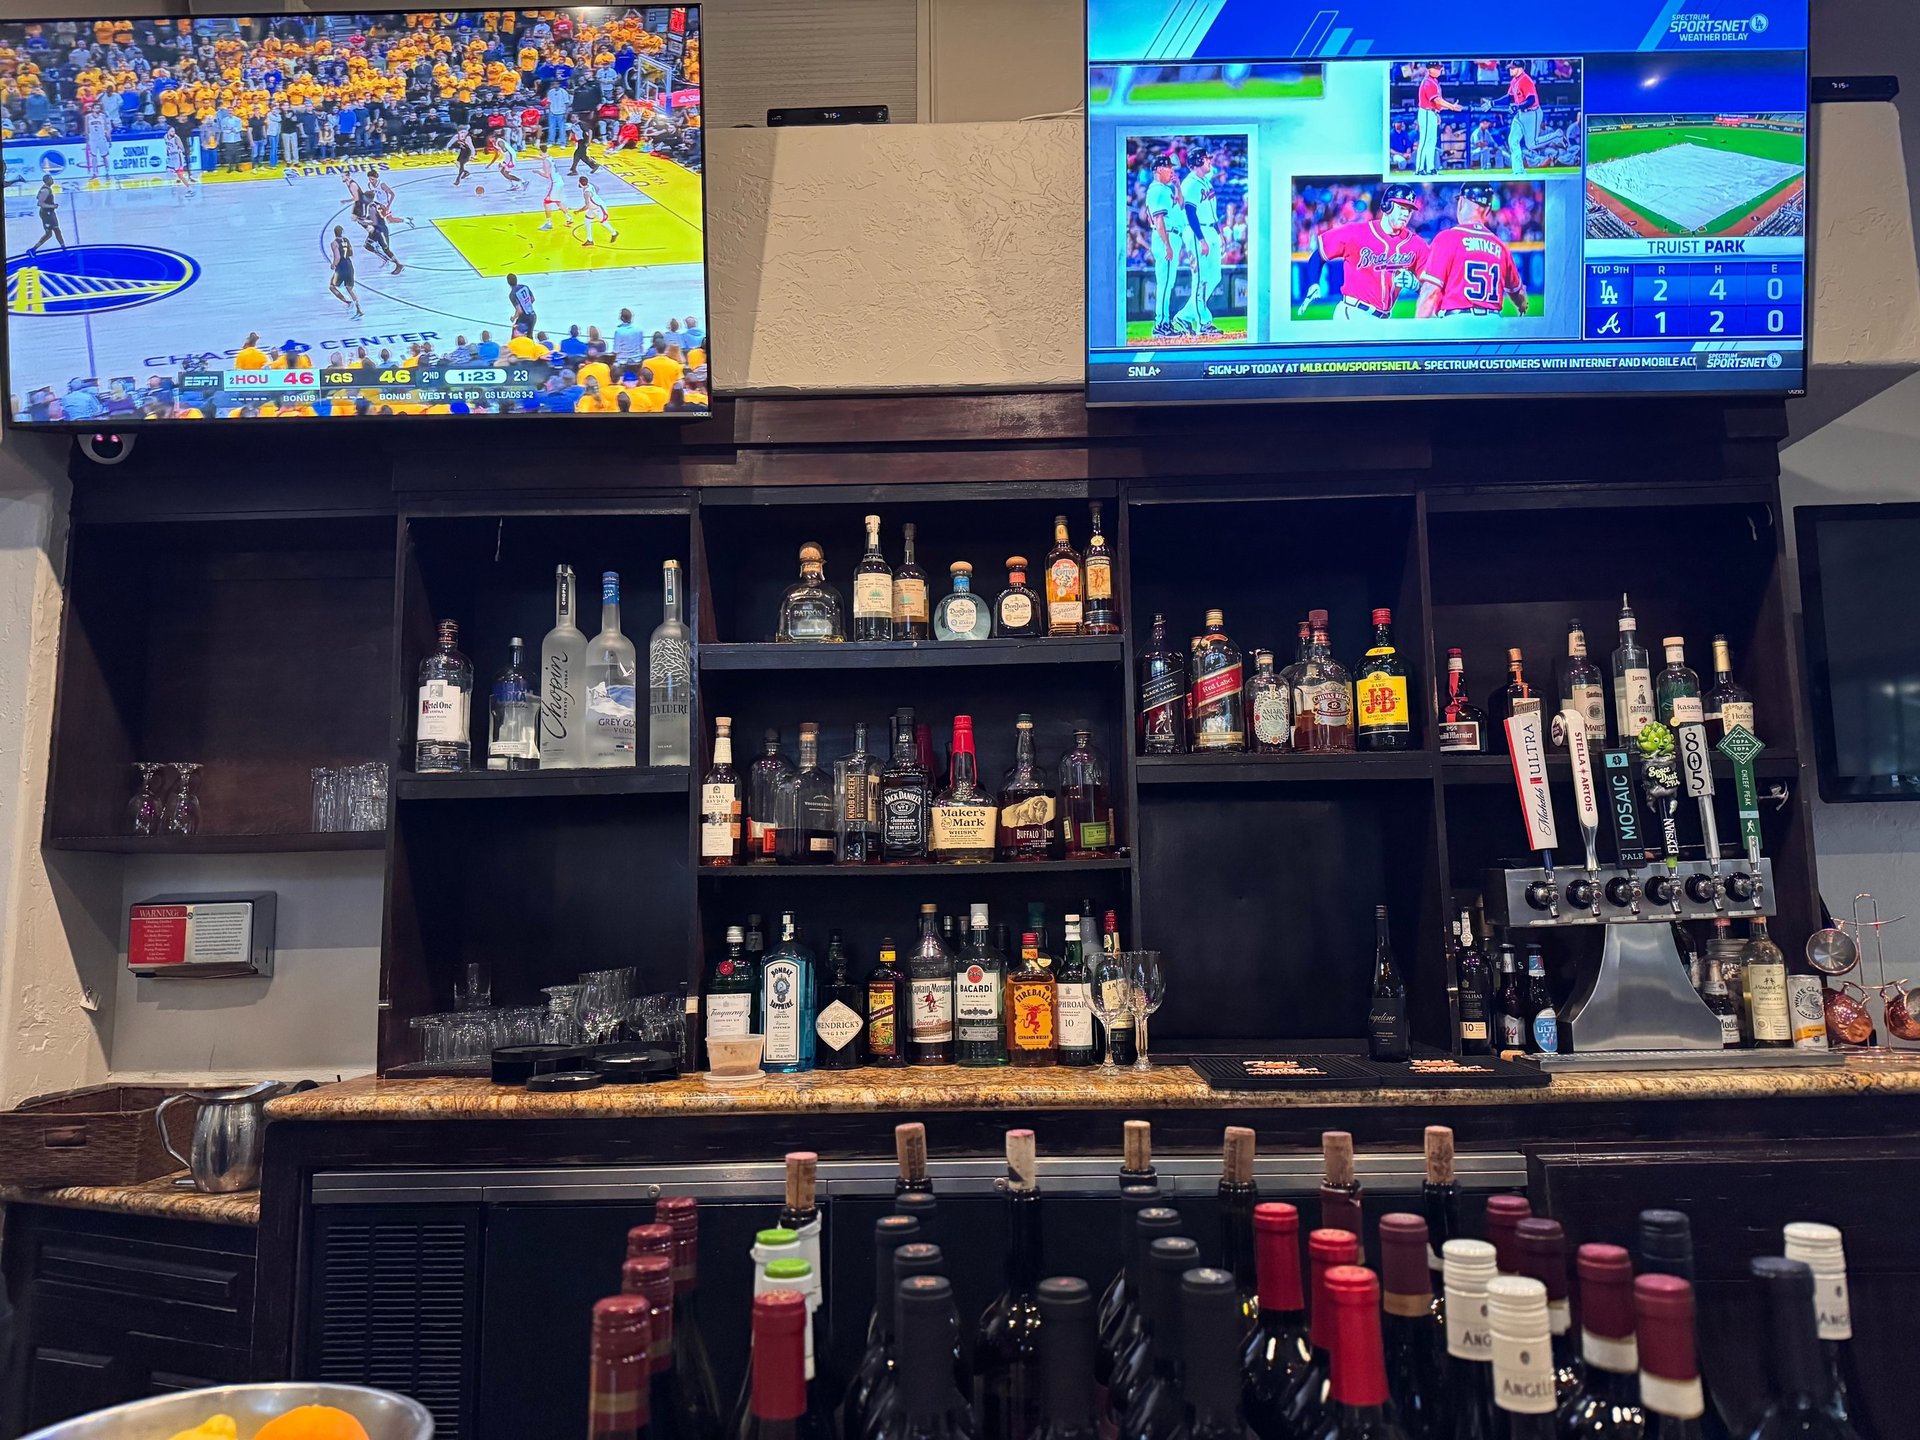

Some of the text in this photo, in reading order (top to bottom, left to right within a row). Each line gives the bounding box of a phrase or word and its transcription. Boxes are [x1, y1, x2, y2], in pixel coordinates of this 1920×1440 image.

[1669, 20, 1749, 33] SPORTSNET
[1679, 33, 1749, 42] WEATHER DELAY
[123, 146, 149, 157] SUNDAY
[113, 157, 147, 169] 8:30PM ET
[303, 161, 390, 177] PLAYOFFS
[1647, 240, 1746, 254] TRUIST PARK
[1591, 265, 1629, 274] TOP 9TH
[1658, 265, 1666, 275] R
[1714, 264, 1722, 274] H
[1771, 264, 1778, 274] E
[1464, 261, 1499, 302] 51
[1653, 279, 1668, 301] 2
[1709, 279, 1726, 300] 4
[1767, 278, 1783, 300] 0
[1655, 311, 1666, 333] 1
[1709, 311, 1724, 333] 2
[1767, 310, 1783, 332] 0
[319, 330, 441, 350] CENTER
[1208, 364, 1250, 375] SIGN-UP
[1252, 364, 1285, 374] TODAY
[1285, 363, 1299, 373] AT
[1424, 360, 1479, 371] SPECTRUM
[1480, 359, 1540, 370] CUSTOMERS
[1542, 358, 1567, 369] WITH
[1569, 358, 1616, 368] INTERNET
[1618, 358, 1641, 368] AND
[1642, 357, 1678, 367] MOBILE
[1706, 358, 1766, 369] SPORTSNET
[379, 370, 411, 384] 46
[422, 371, 439, 383] 2ND
[458, 371, 496, 382] 1:23
[513, 370, 528, 382] 23
[1128, 366, 1161, 377] SNLA+
[185, 376, 218, 386] ESPN
[283, 372, 314, 385] 46
[283, 394, 316, 402] BONUS
[419, 391, 480, 400] WEST 1st RD
[497, 391, 521, 399] LEADS
[1160, 682, 1177, 691] LABEL
[1202, 678, 1234, 693] Red Label
[541, 652, 576, 739] Chopin
[1365, 687, 1397, 714] J&B
[439, 701, 453, 710] One
[650, 704, 688, 715] ELVEDERE
[598, 718, 621, 727] GREY
[1685, 732, 1705, 790] 805
[1574, 732, 1593, 812] STELLA ARTOIS
[1648, 766, 1671, 778] Space
[1659, 772, 1678, 783] Dust
[1523, 723, 1552, 836] Michelob ULTRA
[1741, 769, 1752, 806] CHIEF PEAK
[847, 775, 856, 819] KNOB CREEK
[884, 792, 899, 805] JACK
[941, 809, 986, 817] Maker's
[1612, 775, 1637, 839] MOSAIC
[953, 818, 985, 827] Mark
[1663, 818, 1679, 854] ELYSIAN
[1621, 853, 1644, 861] PALE
[771, 967, 793, 977] BOMBAY
[912, 982, 951, 994] Captain Morgan
[960, 982, 993, 993] BACARDÍ
[1015, 988, 1052, 1003] FIREBALL
[1795, 988, 1808, 1007] WHITE
[769, 998, 794, 1010] SAPPHIRE
[817, 1020, 860, 1029] HENDRICK'S
[1065, 1019, 1074, 1027] 10
[1464, 1023, 1474, 1031] 10
